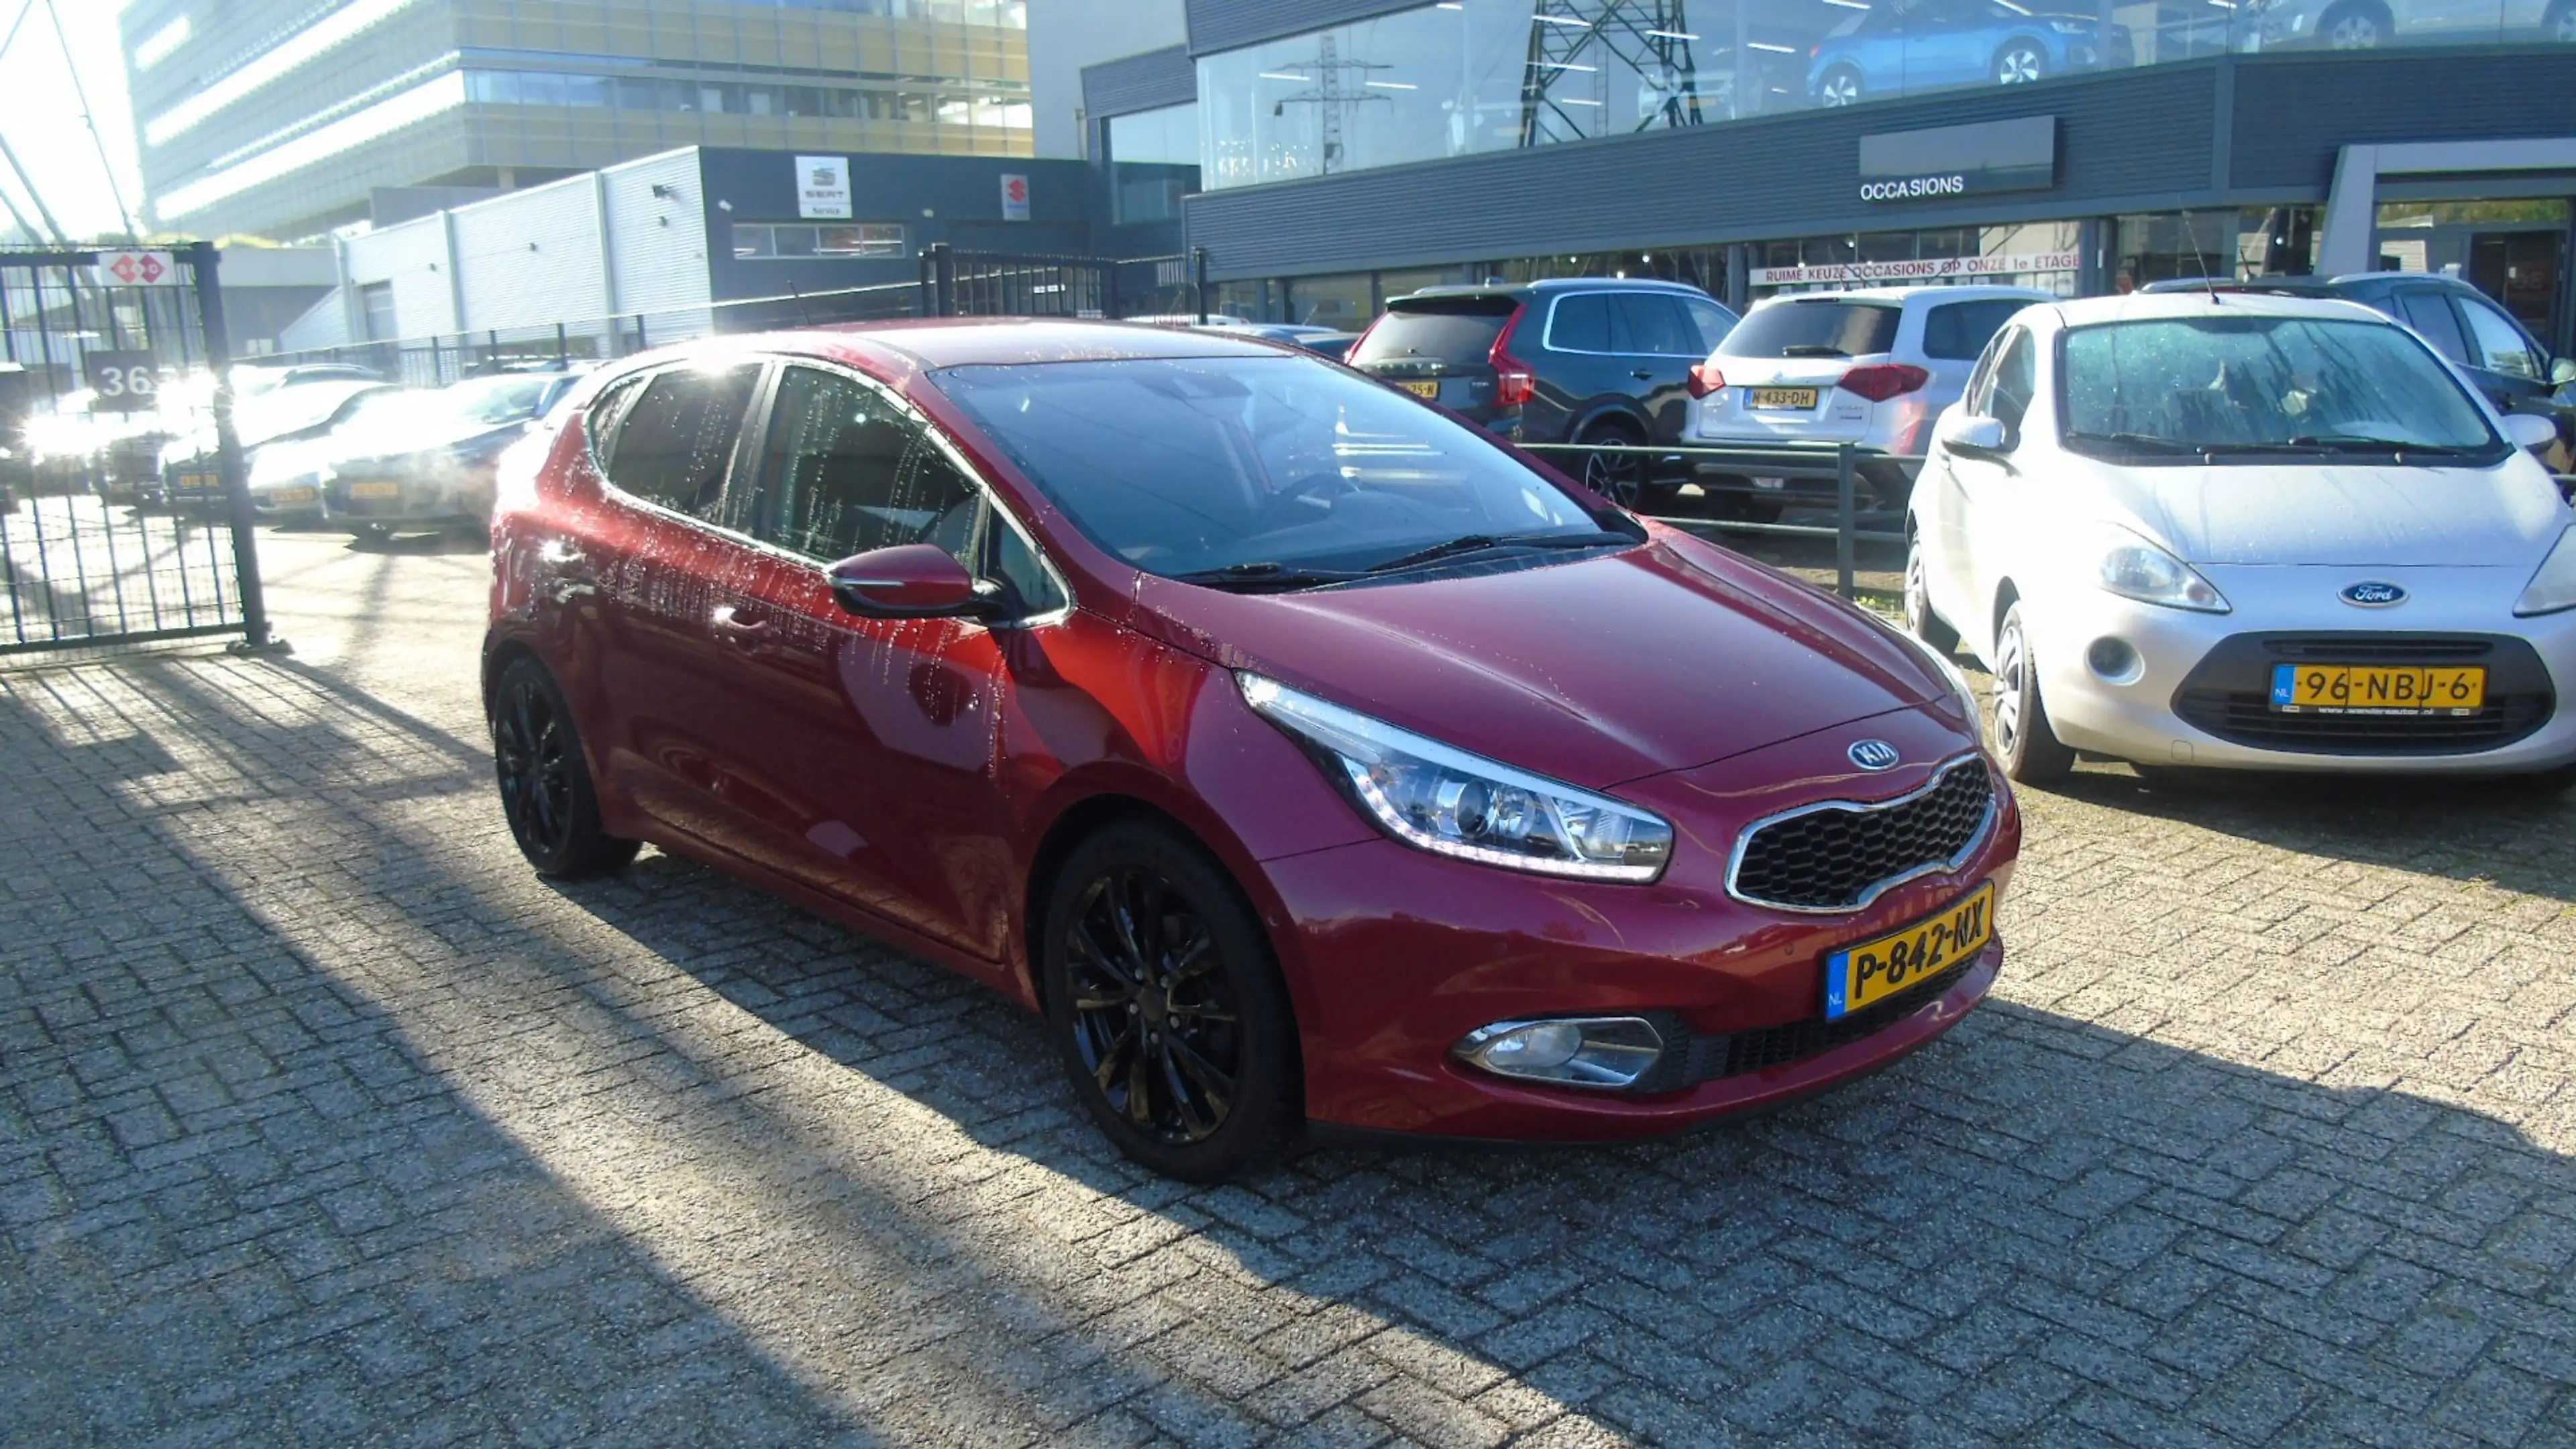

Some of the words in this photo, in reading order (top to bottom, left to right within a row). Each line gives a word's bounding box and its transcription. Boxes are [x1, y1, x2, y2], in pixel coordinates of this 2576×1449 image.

[1860, 176, 1964, 201] OCCASIONS
[1766, 270, 1803, 282] RUIME
[1808, 268, 1847, 280] KEUZE
[1854, 261, 1935, 278] OCCASIONS
[1941, 260, 1961, 273] OP
[1967, 258, 2005, 272] ONZE
[2035, 254, 2080, 269] ETAGE
[101, 366, 154, 396] 36
[2355, 585, 2393, 600] Ford
[2275, 688, 2290, 698] NL
[2306, 672, 2471, 700] 96-NBJ-6
[1854, 743, 1896, 765] KIA
[1855, 896, 1986, 999] P-842-NX
[1828, 994, 1843, 1005] NL
